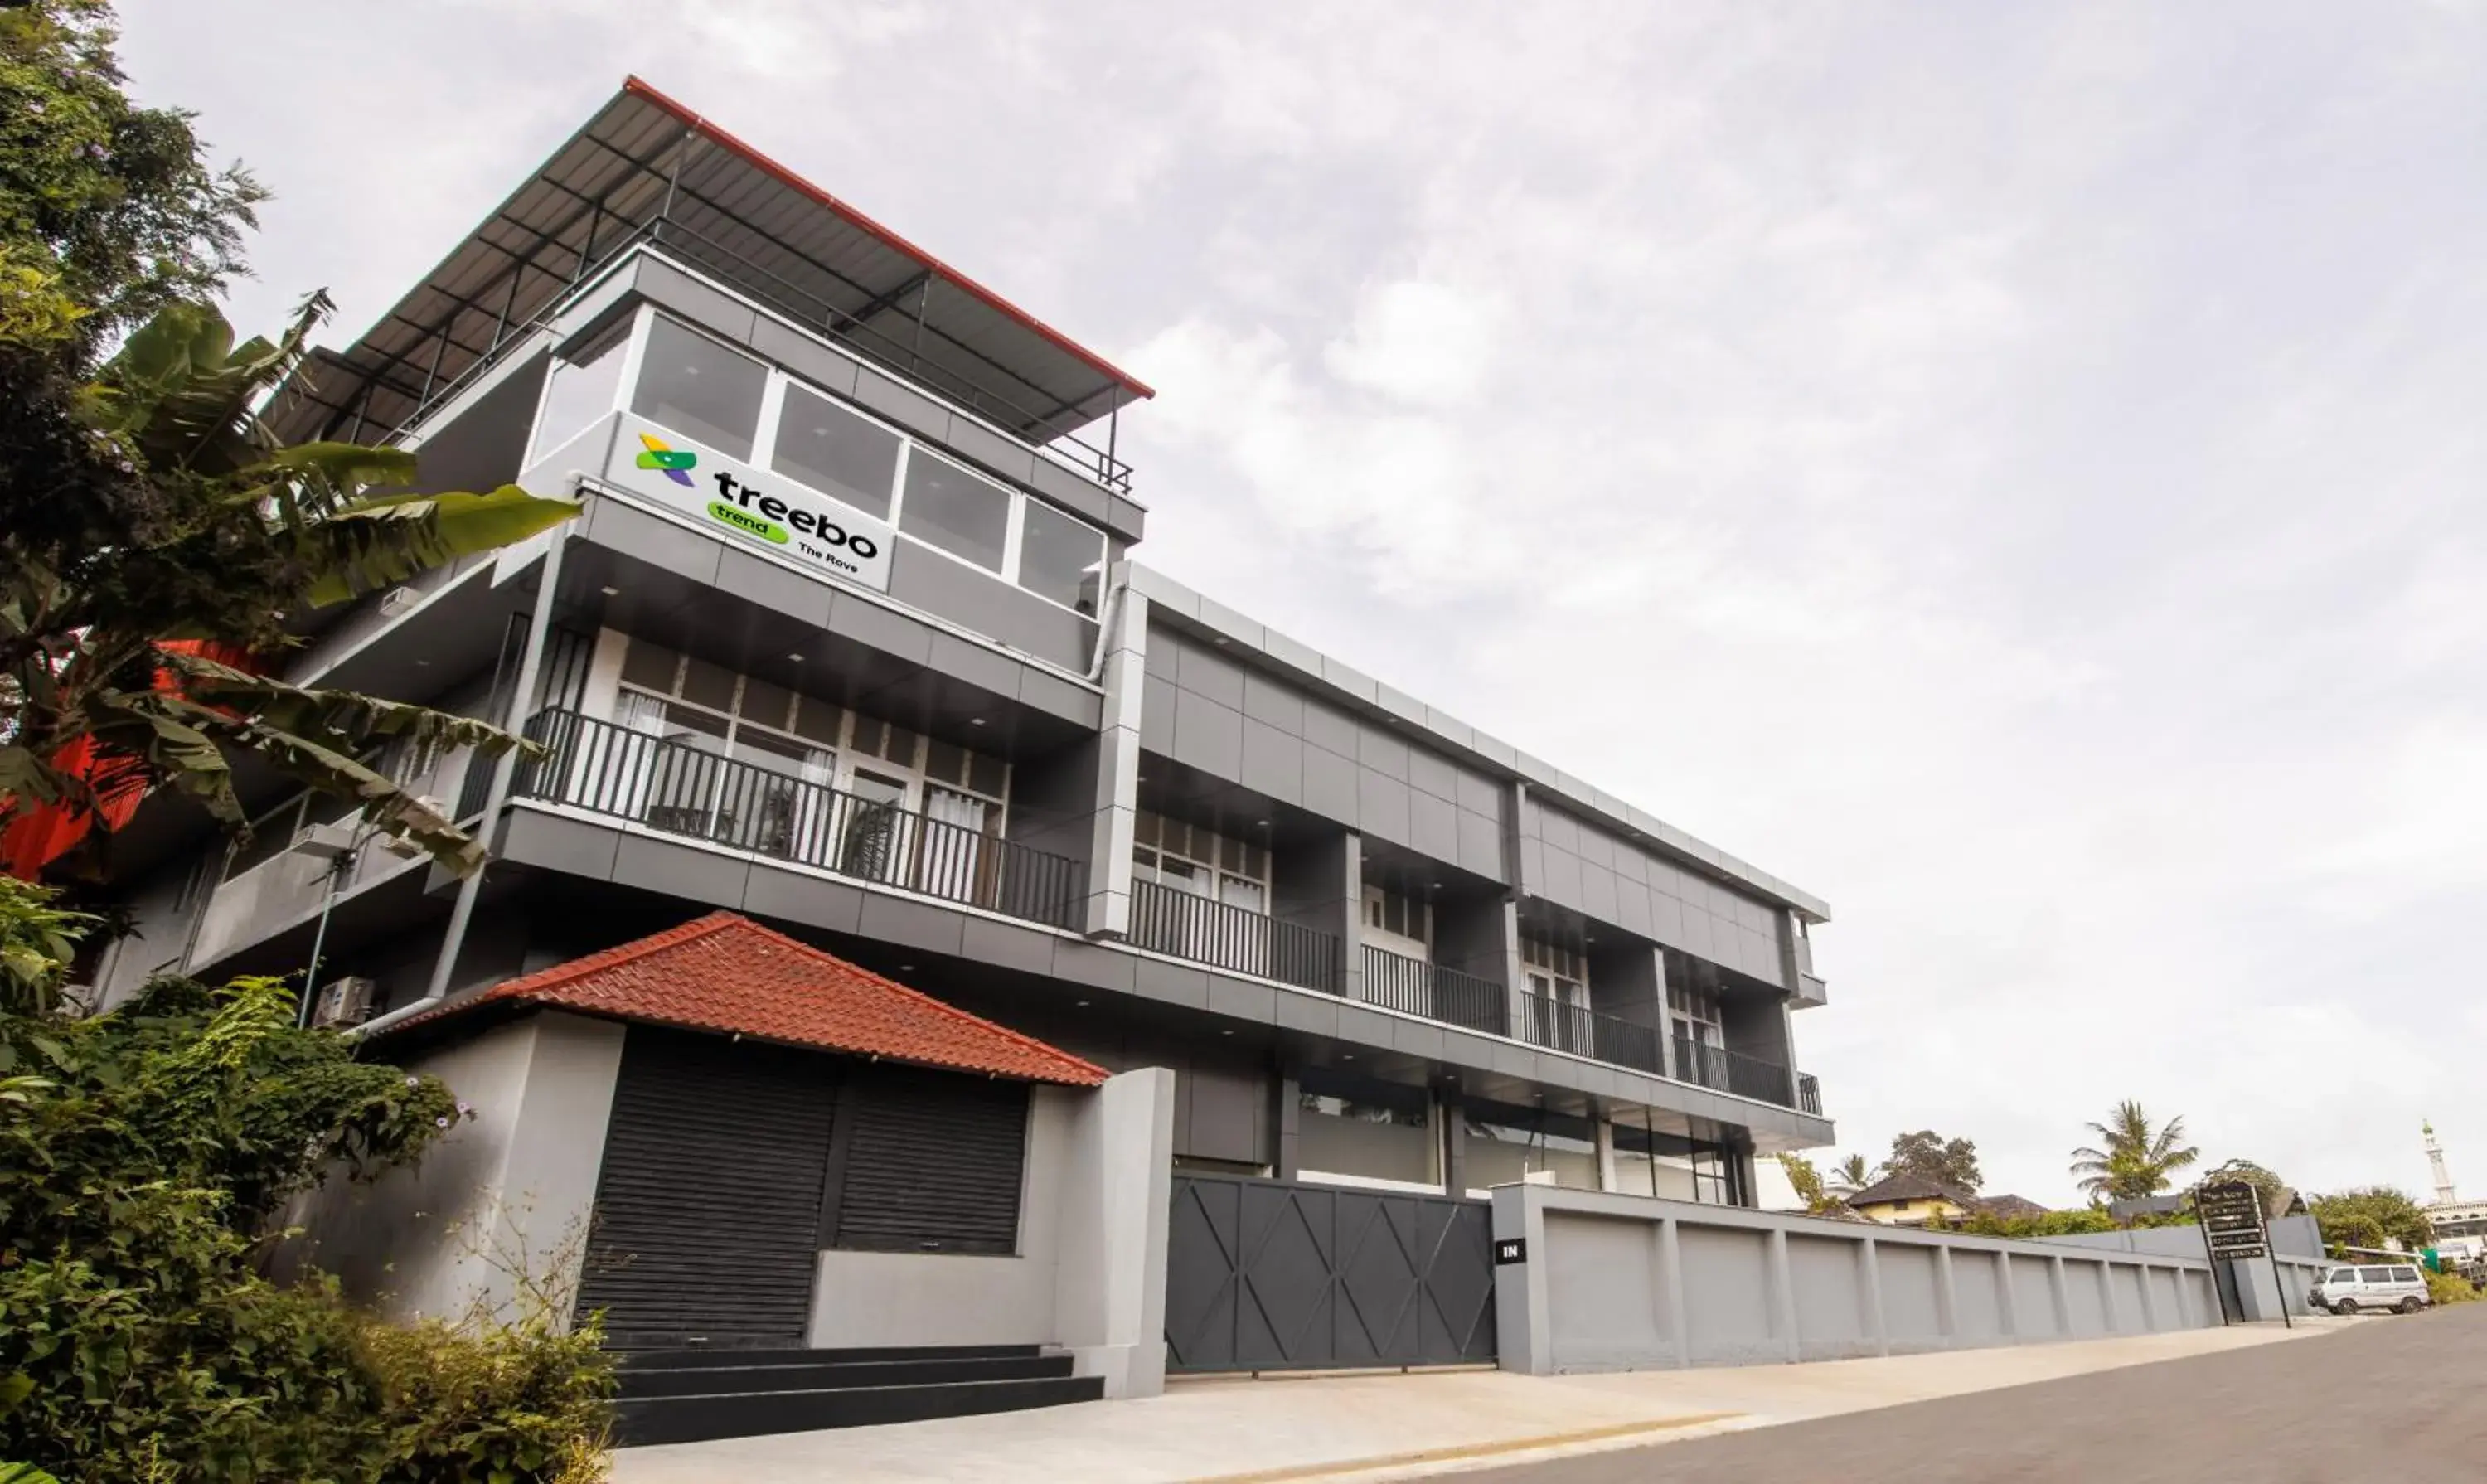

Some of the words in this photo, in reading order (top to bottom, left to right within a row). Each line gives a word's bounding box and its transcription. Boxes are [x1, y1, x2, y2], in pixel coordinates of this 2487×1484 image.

[714, 471, 878, 558] treebo
[716, 505, 768, 534] trend
[799, 541, 823, 559] The
[826, 553, 858, 573] Rove
[1503, 1244, 1518, 1258] IN
